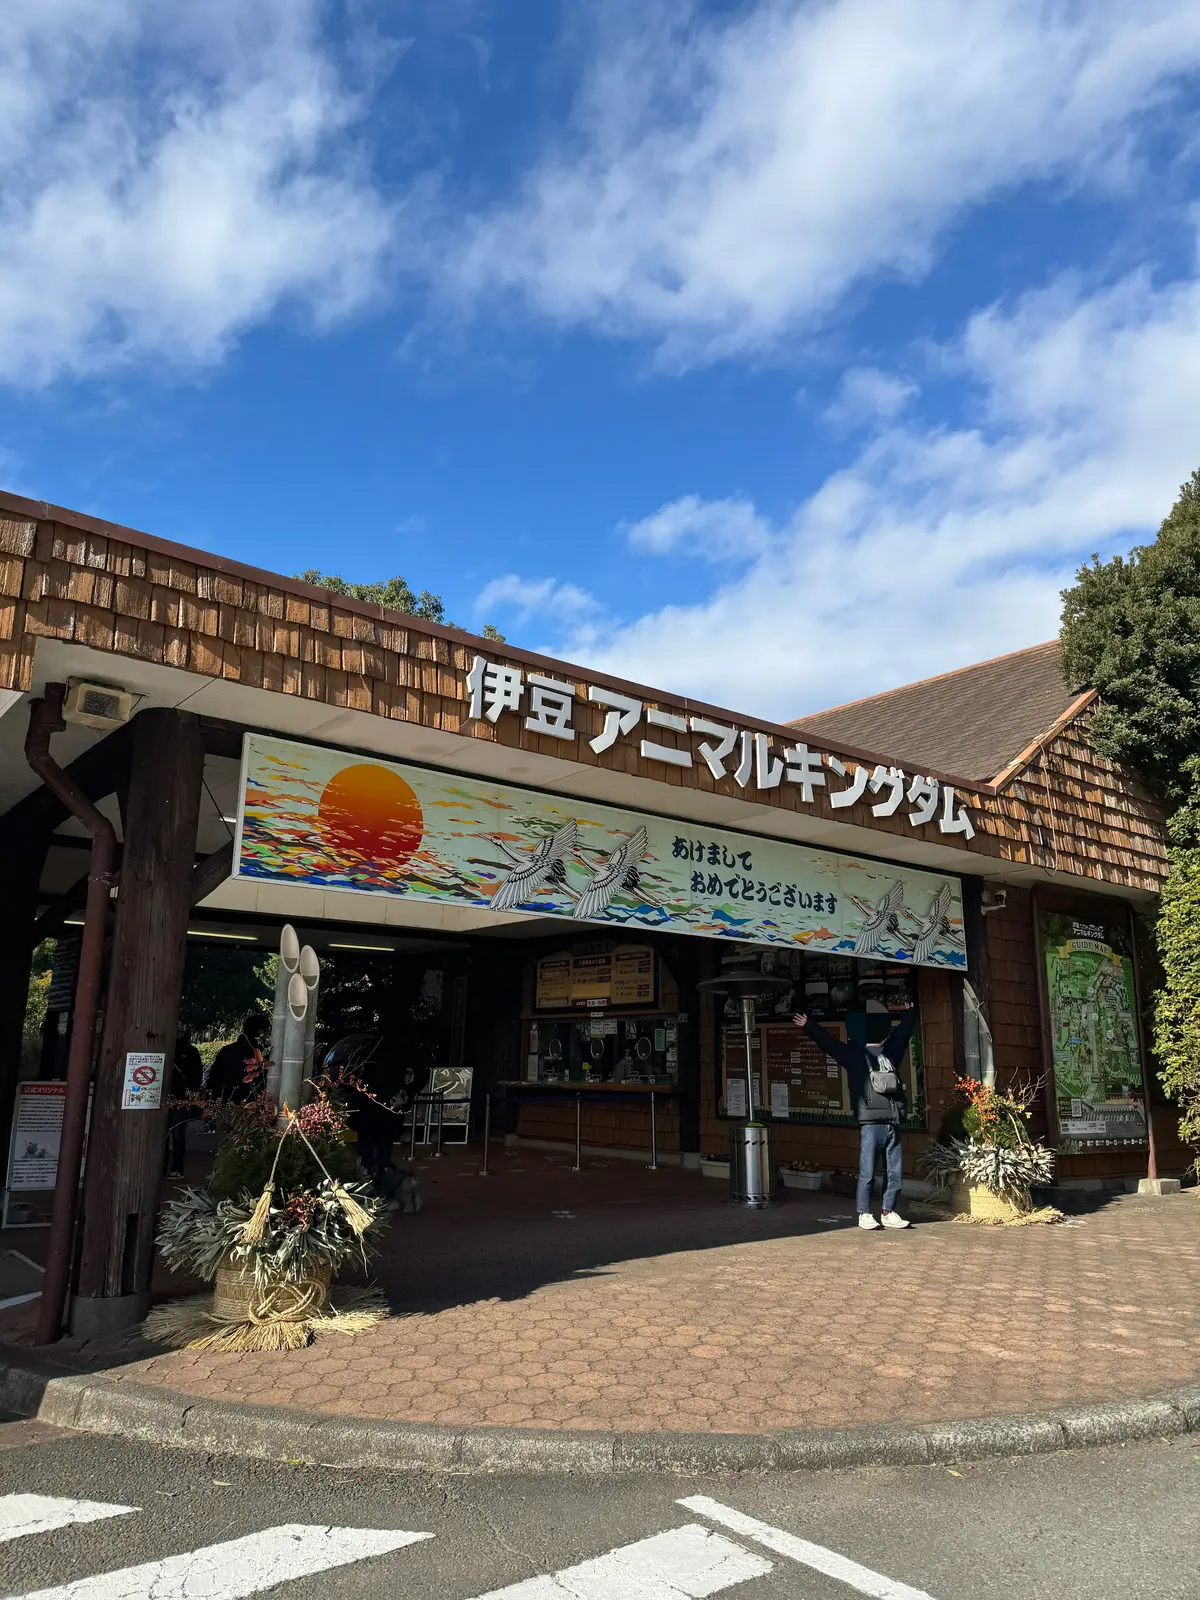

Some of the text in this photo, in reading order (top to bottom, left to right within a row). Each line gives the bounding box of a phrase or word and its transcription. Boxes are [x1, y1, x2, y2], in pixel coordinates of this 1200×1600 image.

[466, 655, 976, 840] 伊豆アニマルキングダム
[672, 835, 753, 872] あけまして
[690, 870, 838, 915] おめでとうございます
[1072, 941, 1108, 953] GUIDE MAP
